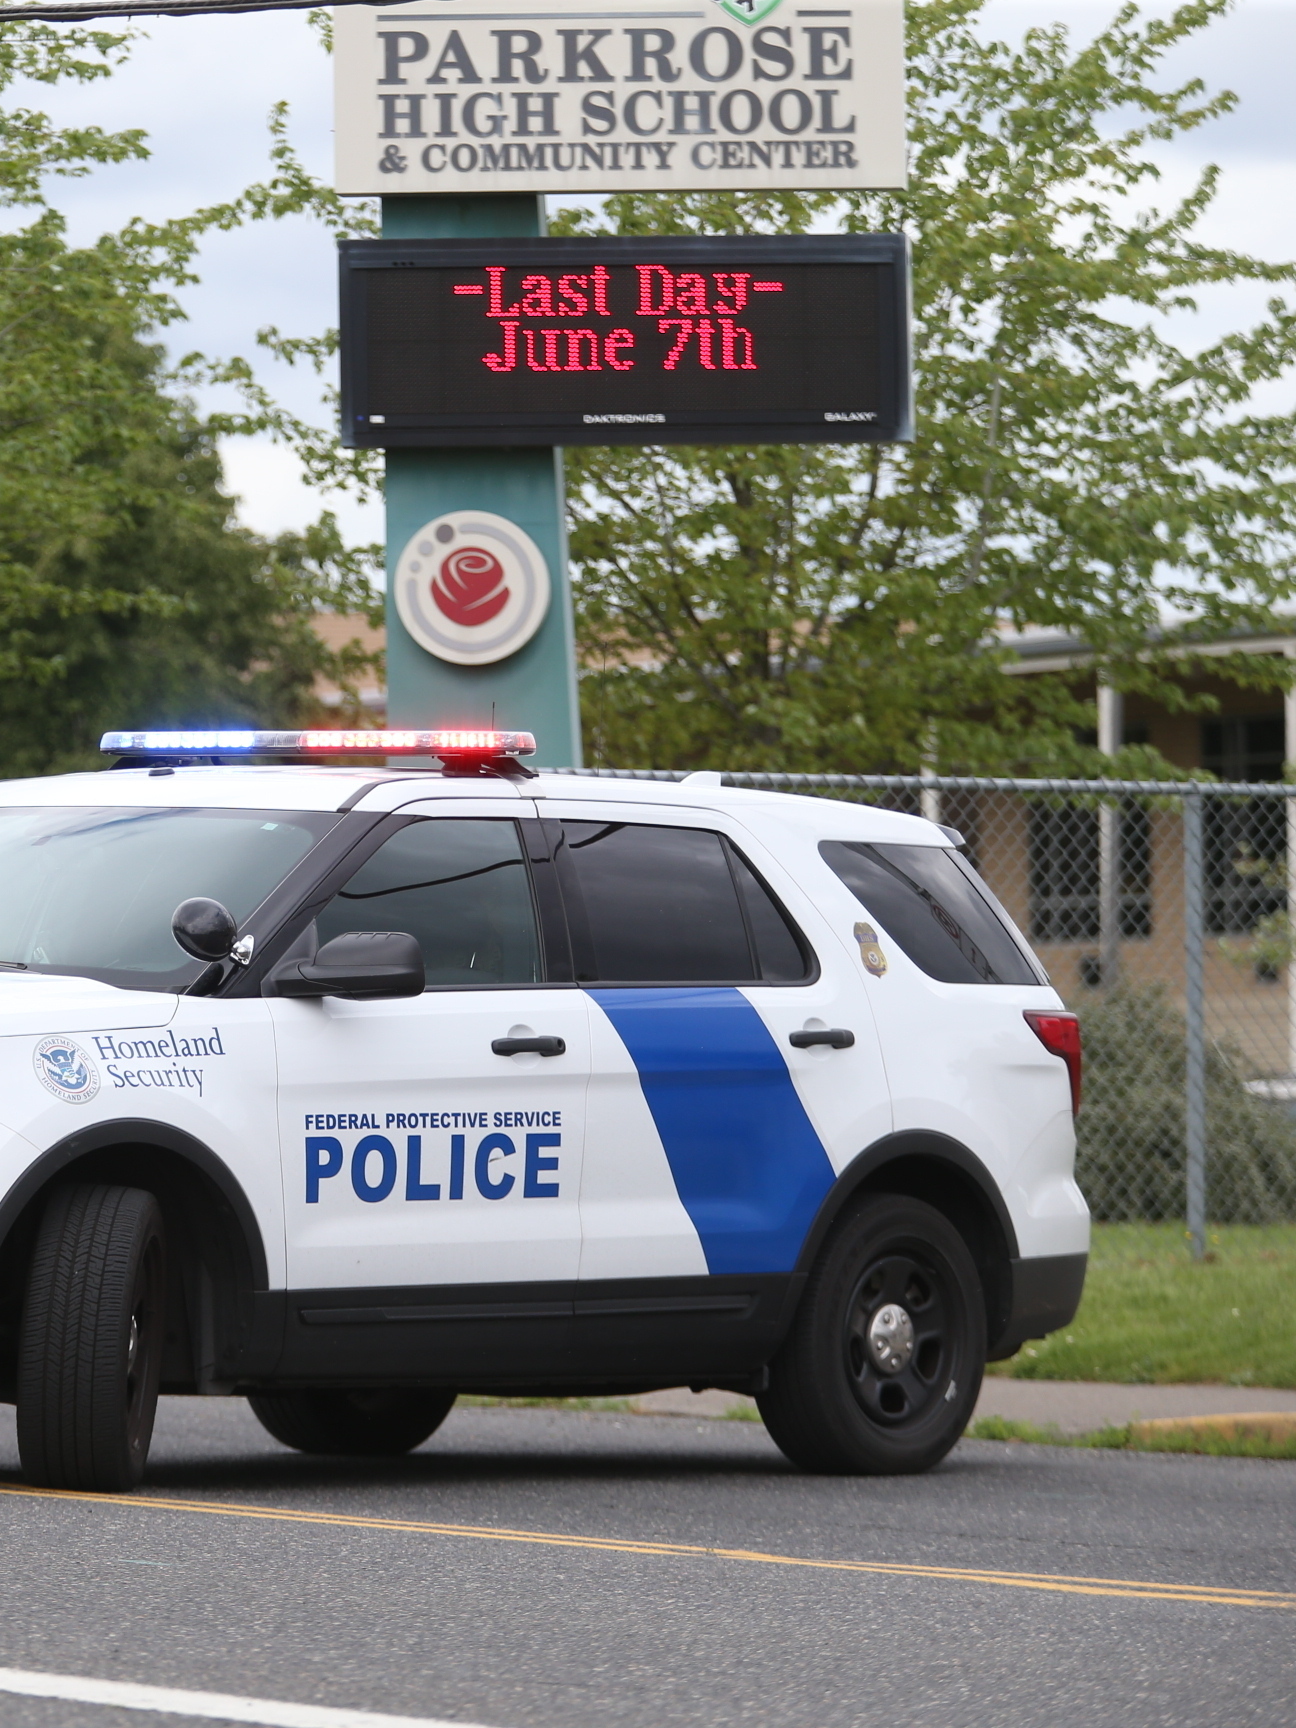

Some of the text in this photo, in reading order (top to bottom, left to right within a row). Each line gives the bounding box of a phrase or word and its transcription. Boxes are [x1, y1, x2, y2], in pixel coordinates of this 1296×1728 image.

[377, 26, 853, 85] PARKROSE
[378, 89, 856, 139] HIGH SCHOOL
[378, 139, 858, 174] & COMMUNITY CENTER
[482, 318, 757, 372] June 7th
[583, 414, 666, 424] DAKTRONICS
[824, 411, 874, 422] GALAXY
[91, 1027, 226, 1060] Homeland
[41, 1069, 98, 1101] HOMELAND SECURITY
[106, 1062, 204, 1098] Security
[305, 1111, 562, 1130] FEDERAL PROTECTIVE SERVICE
[305, 1132, 562, 1204] POLICE
